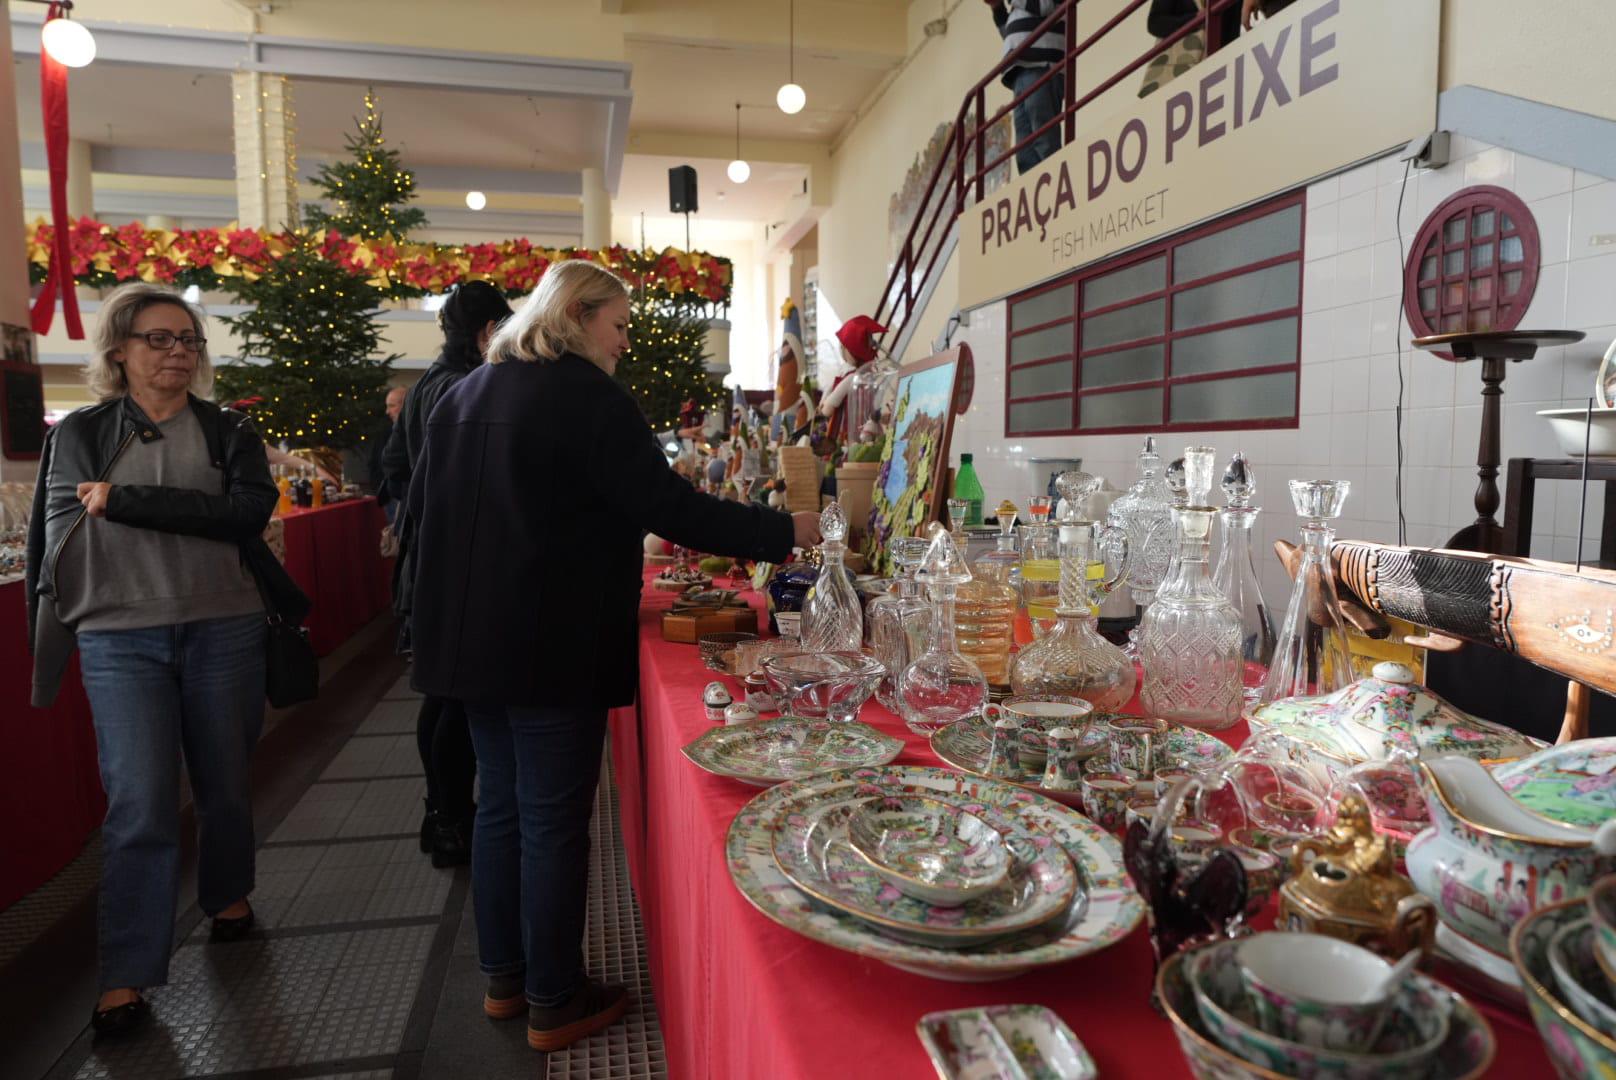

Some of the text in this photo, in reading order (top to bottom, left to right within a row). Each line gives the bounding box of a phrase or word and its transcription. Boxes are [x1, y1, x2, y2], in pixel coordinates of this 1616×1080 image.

[982, 0, 1340, 255] PRAÇA DO PEIXE
[1052, 188, 1169, 264] FISH MARKET
